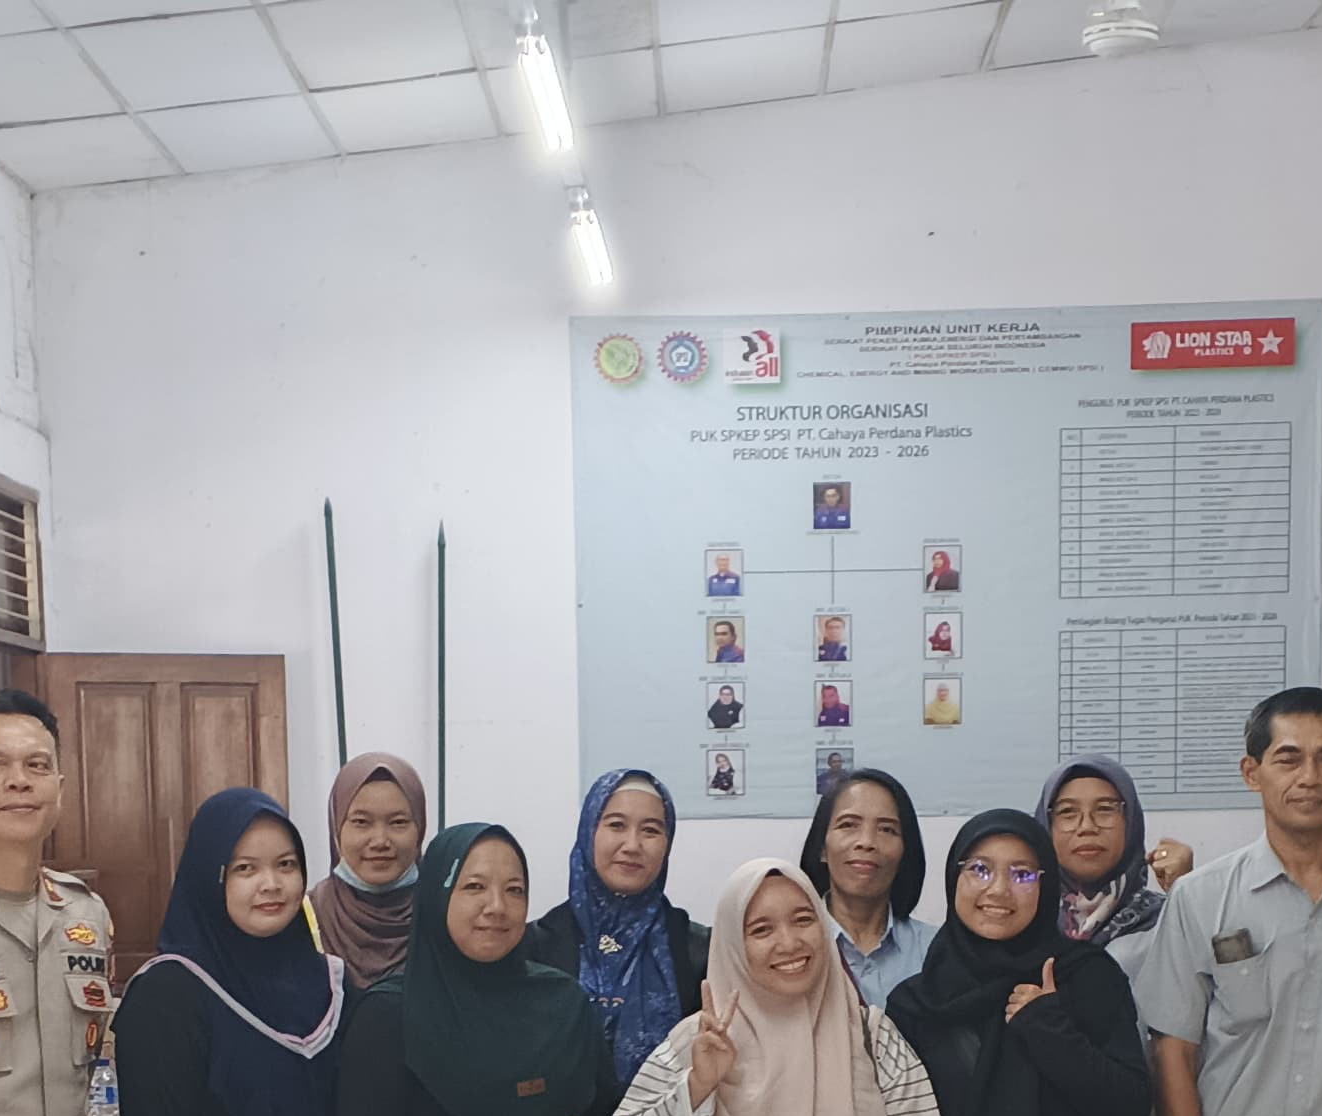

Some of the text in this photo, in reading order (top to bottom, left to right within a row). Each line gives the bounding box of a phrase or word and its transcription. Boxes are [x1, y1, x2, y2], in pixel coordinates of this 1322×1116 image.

[864, 322, 1041, 336] PIMPINAN UNIT KERJA
[1175, 330, 1252, 348] LION STAR
[1193, 347, 1235, 356] PLASTICS
[736, 403, 929, 421] STRUKTUR ORGANISASI
[690, 430, 718, 442] PUK
[720, 429, 761, 441] SPKEP
[763, 429, 791, 441] SPSI
[818, 427, 866, 442] Cahaya
[868, 426, 924, 440] Perdana
[925, 425, 973, 438] Plastics
[733, 447, 789, 460] PERIODE
[795, 446, 841, 459] TAHUN
[847, 446, 880, 458] 2023
[896, 445, 930, 457] 2026
